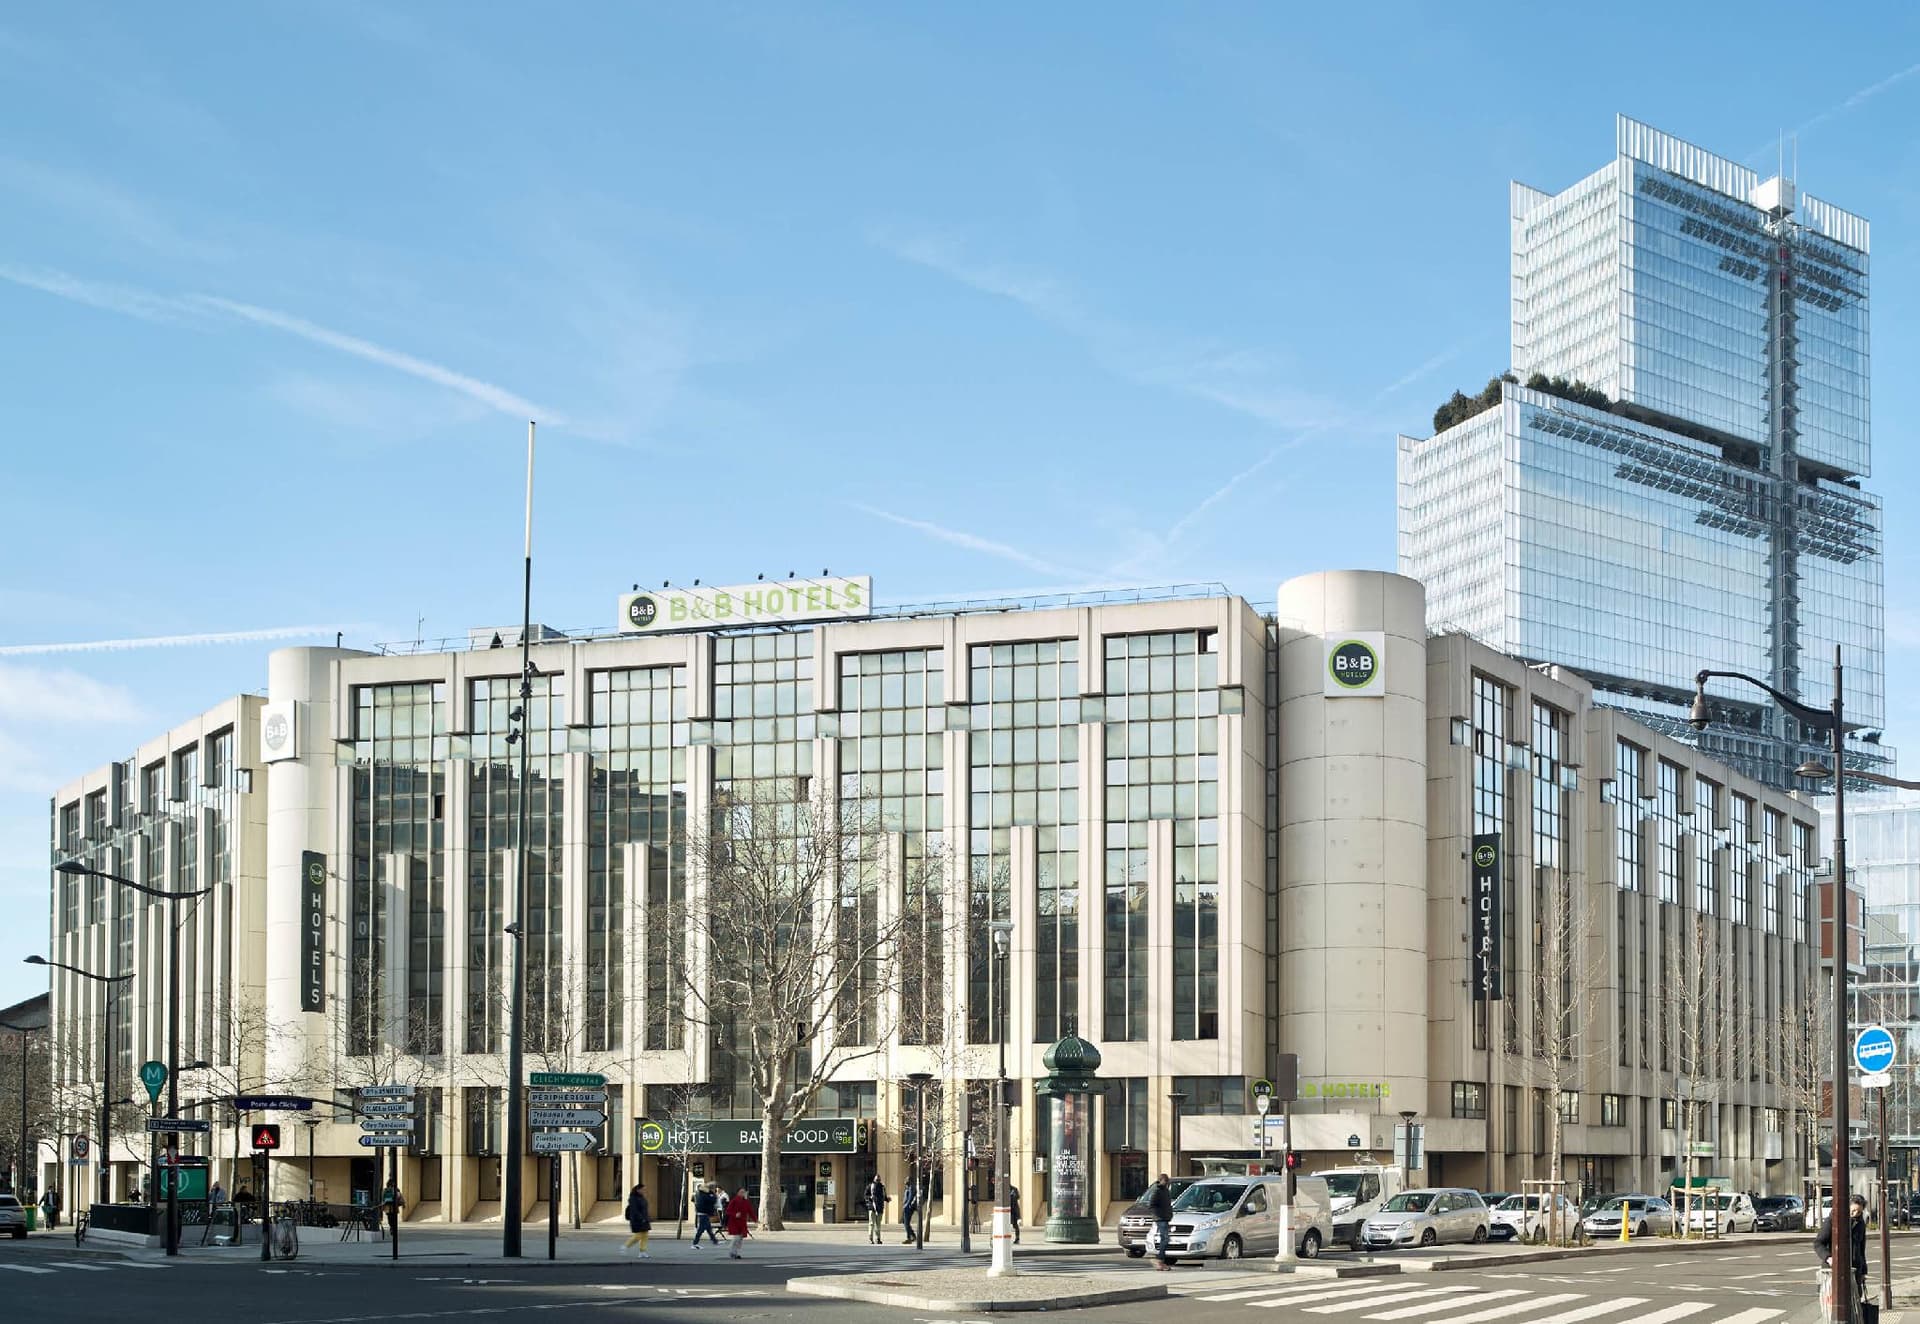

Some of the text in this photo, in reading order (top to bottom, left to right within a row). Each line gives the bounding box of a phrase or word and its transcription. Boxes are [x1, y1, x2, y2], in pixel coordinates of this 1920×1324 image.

[670, 583, 861, 621] B&B HOTELS
[631, 604, 654, 616] B&B
[1335, 655, 1372, 670] B&B
[311, 892, 322, 1004] HOTELS
[146, 1067, 160, 1080] M
[1322, 1082, 1392, 1098] HOTELS
[278, 1101, 298, 1109] Clichy
[642, 1131, 660, 1140] B&B
[667, 1130, 713, 1144] HOTEL
[786, 1130, 829, 1144] FOOD
